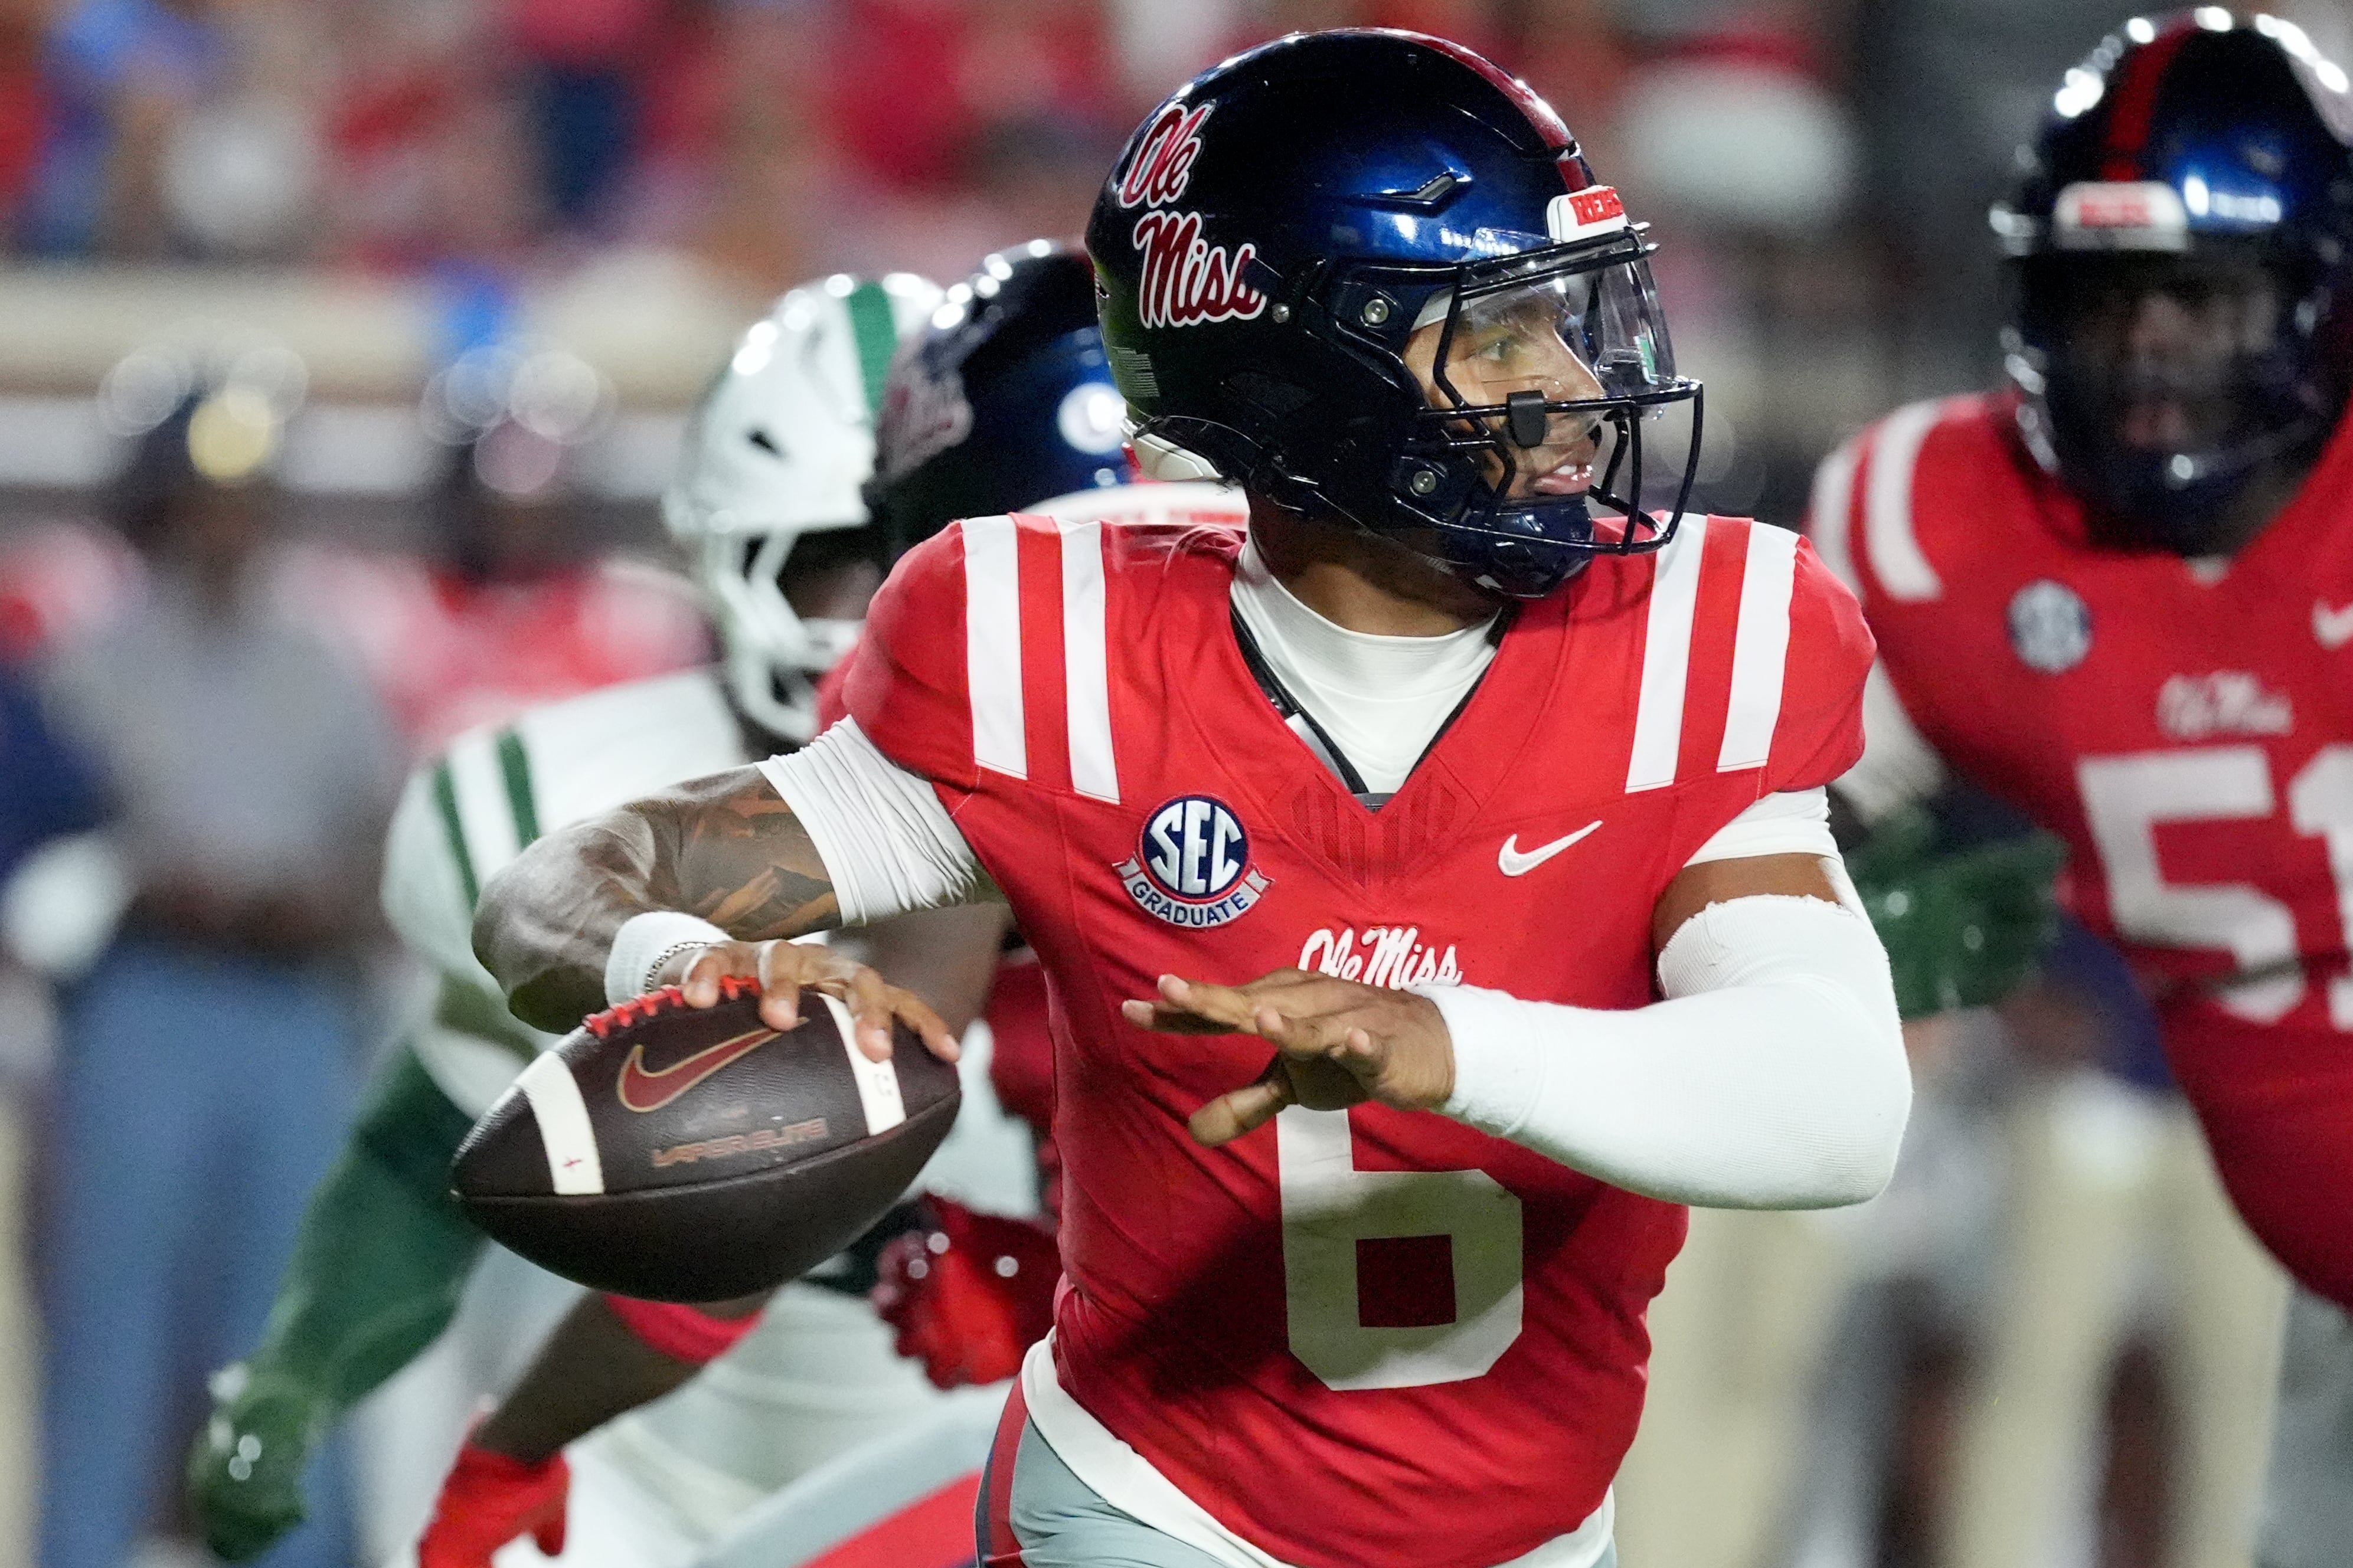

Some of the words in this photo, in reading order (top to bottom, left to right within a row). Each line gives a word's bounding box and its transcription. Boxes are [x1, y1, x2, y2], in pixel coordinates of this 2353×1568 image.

[1120, 102, 1215, 208] Ole
[1133, 210, 1267, 329] Miss
[1149, 800, 1242, 893] SEC
[1132, 881, 1249, 925] GRADUATE
[1298, 928, 1362, 983] Ole
[1361, 926, 1463, 991] Miss
[1276, 1104, 1524, 1392] 6
